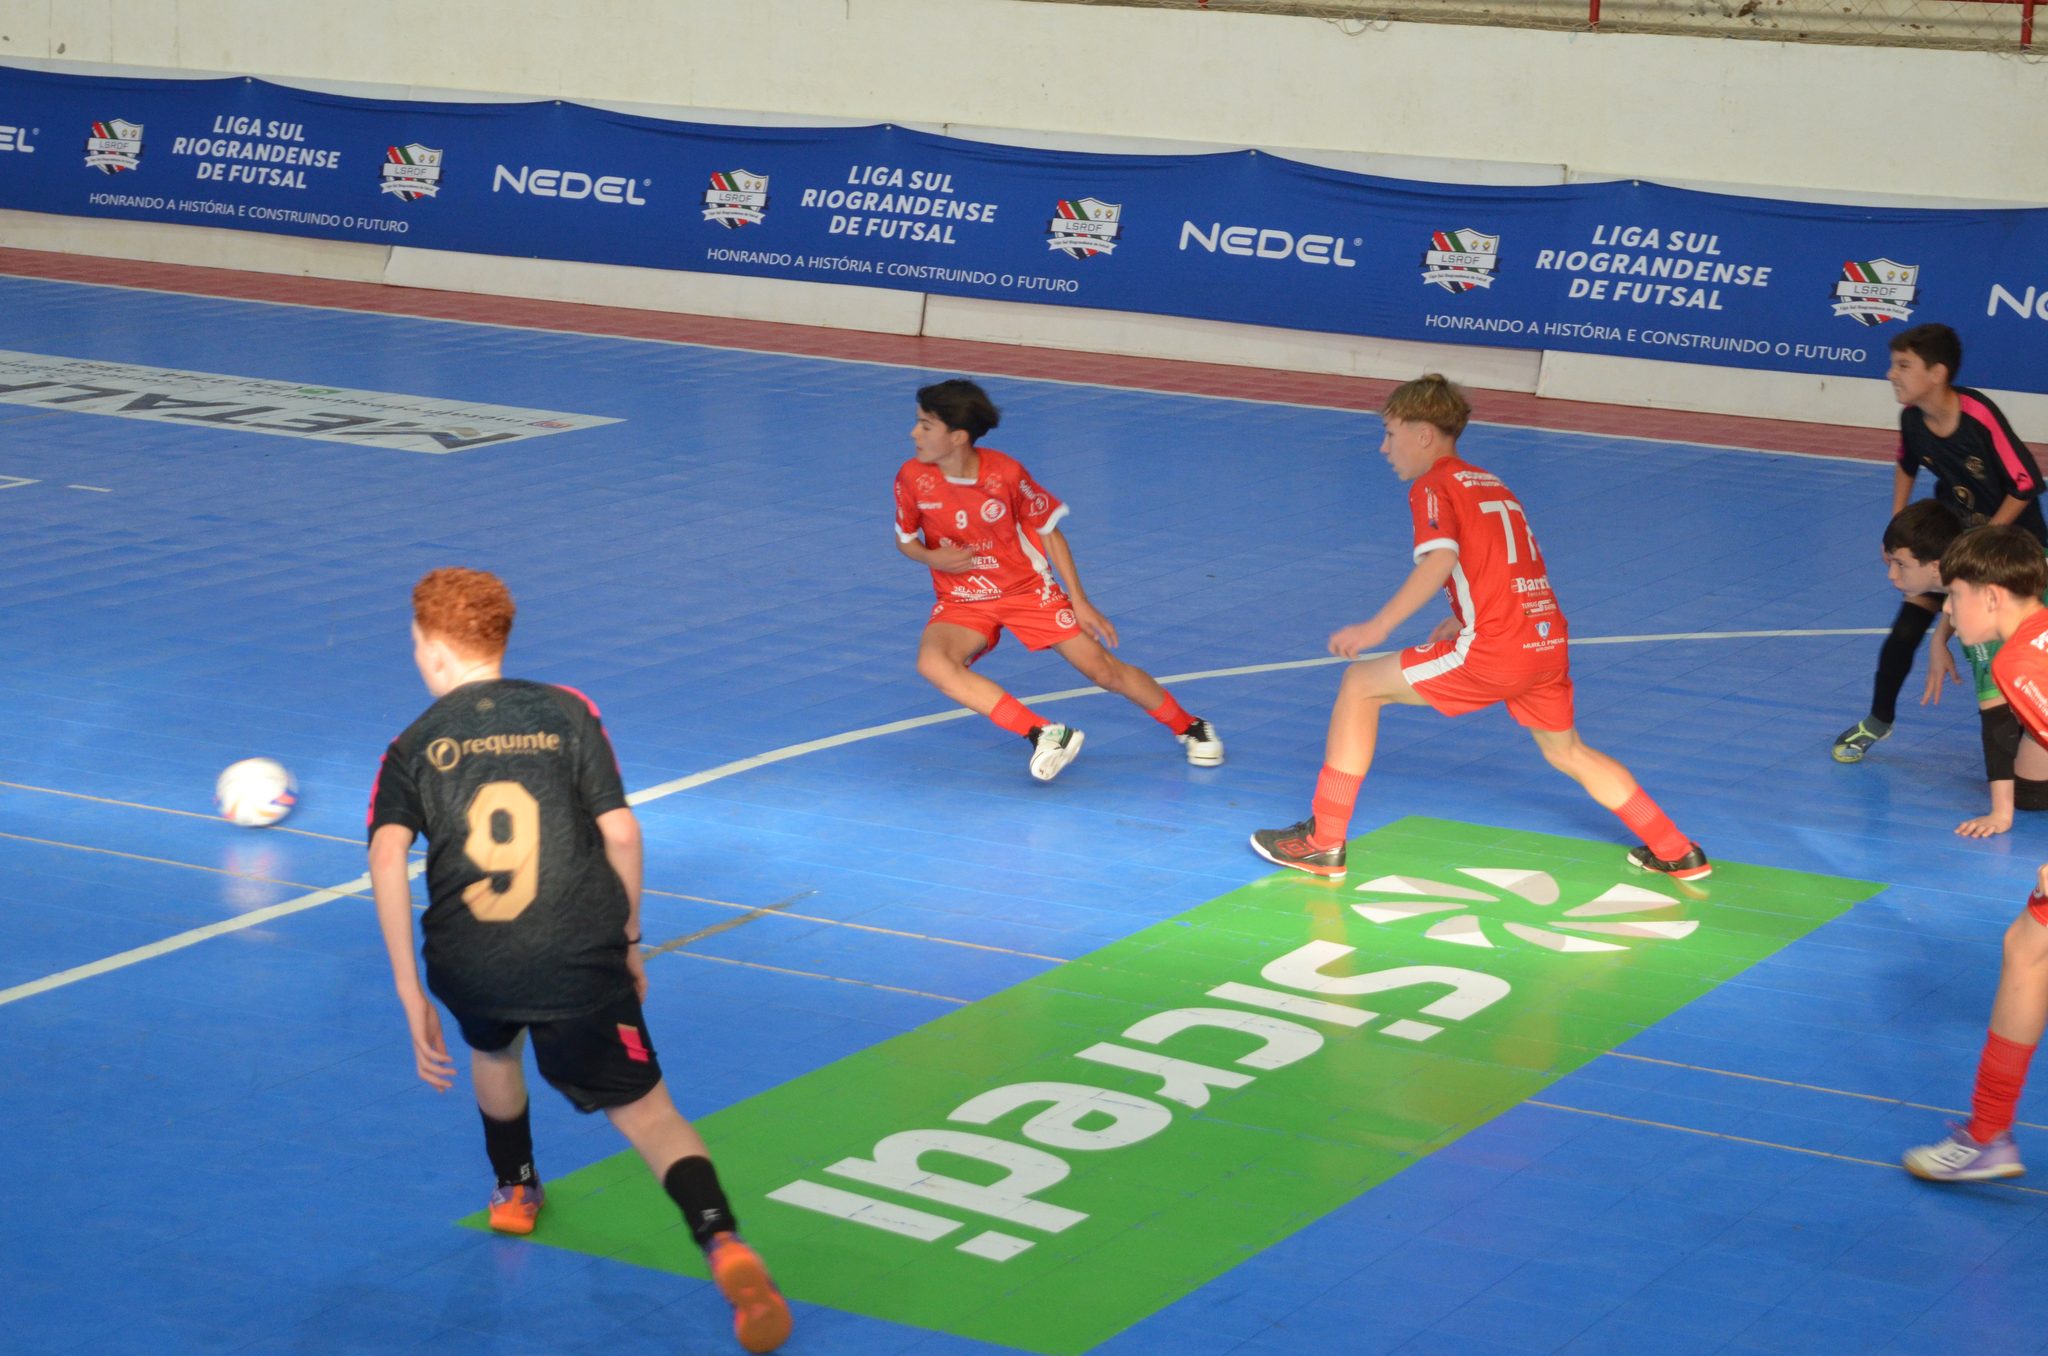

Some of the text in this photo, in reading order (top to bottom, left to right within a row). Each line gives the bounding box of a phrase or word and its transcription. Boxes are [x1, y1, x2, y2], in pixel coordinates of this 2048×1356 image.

[213, 115, 305, 142] LIGA SUL
[172, 137, 341, 169] RIOGRANDENSE
[196, 161, 307, 189] DE FUTSAL
[847, 165, 955, 194] LIGA SUL
[90, 193, 409, 233] HONRANDO A HISTÓRIA E CONSTRUINDO O FUTURO
[801, 188, 998, 223] RIOGRANDENSE
[828, 215, 956, 245] DE FUTSAL
[1591, 224, 1721, 256] LIGA SUL
[707, 248, 1079, 293] HONRANDO A HISTÓRIA E CONSTRUINDO O FUTURO
[1535, 249, 1773, 287] RIOGRANDENSE
[1567, 278, 1723, 311] DE FUTSAL
[1425, 314, 1867, 363] HONRANDO A HISTÓRIA E CONSTRUINDO O FUTURO
[955, 511, 968, 529] 9
[461, 730, 560, 755] requinte
[462, 780, 541, 922] 9
[766, 939, 1511, 1262] Sicredi
